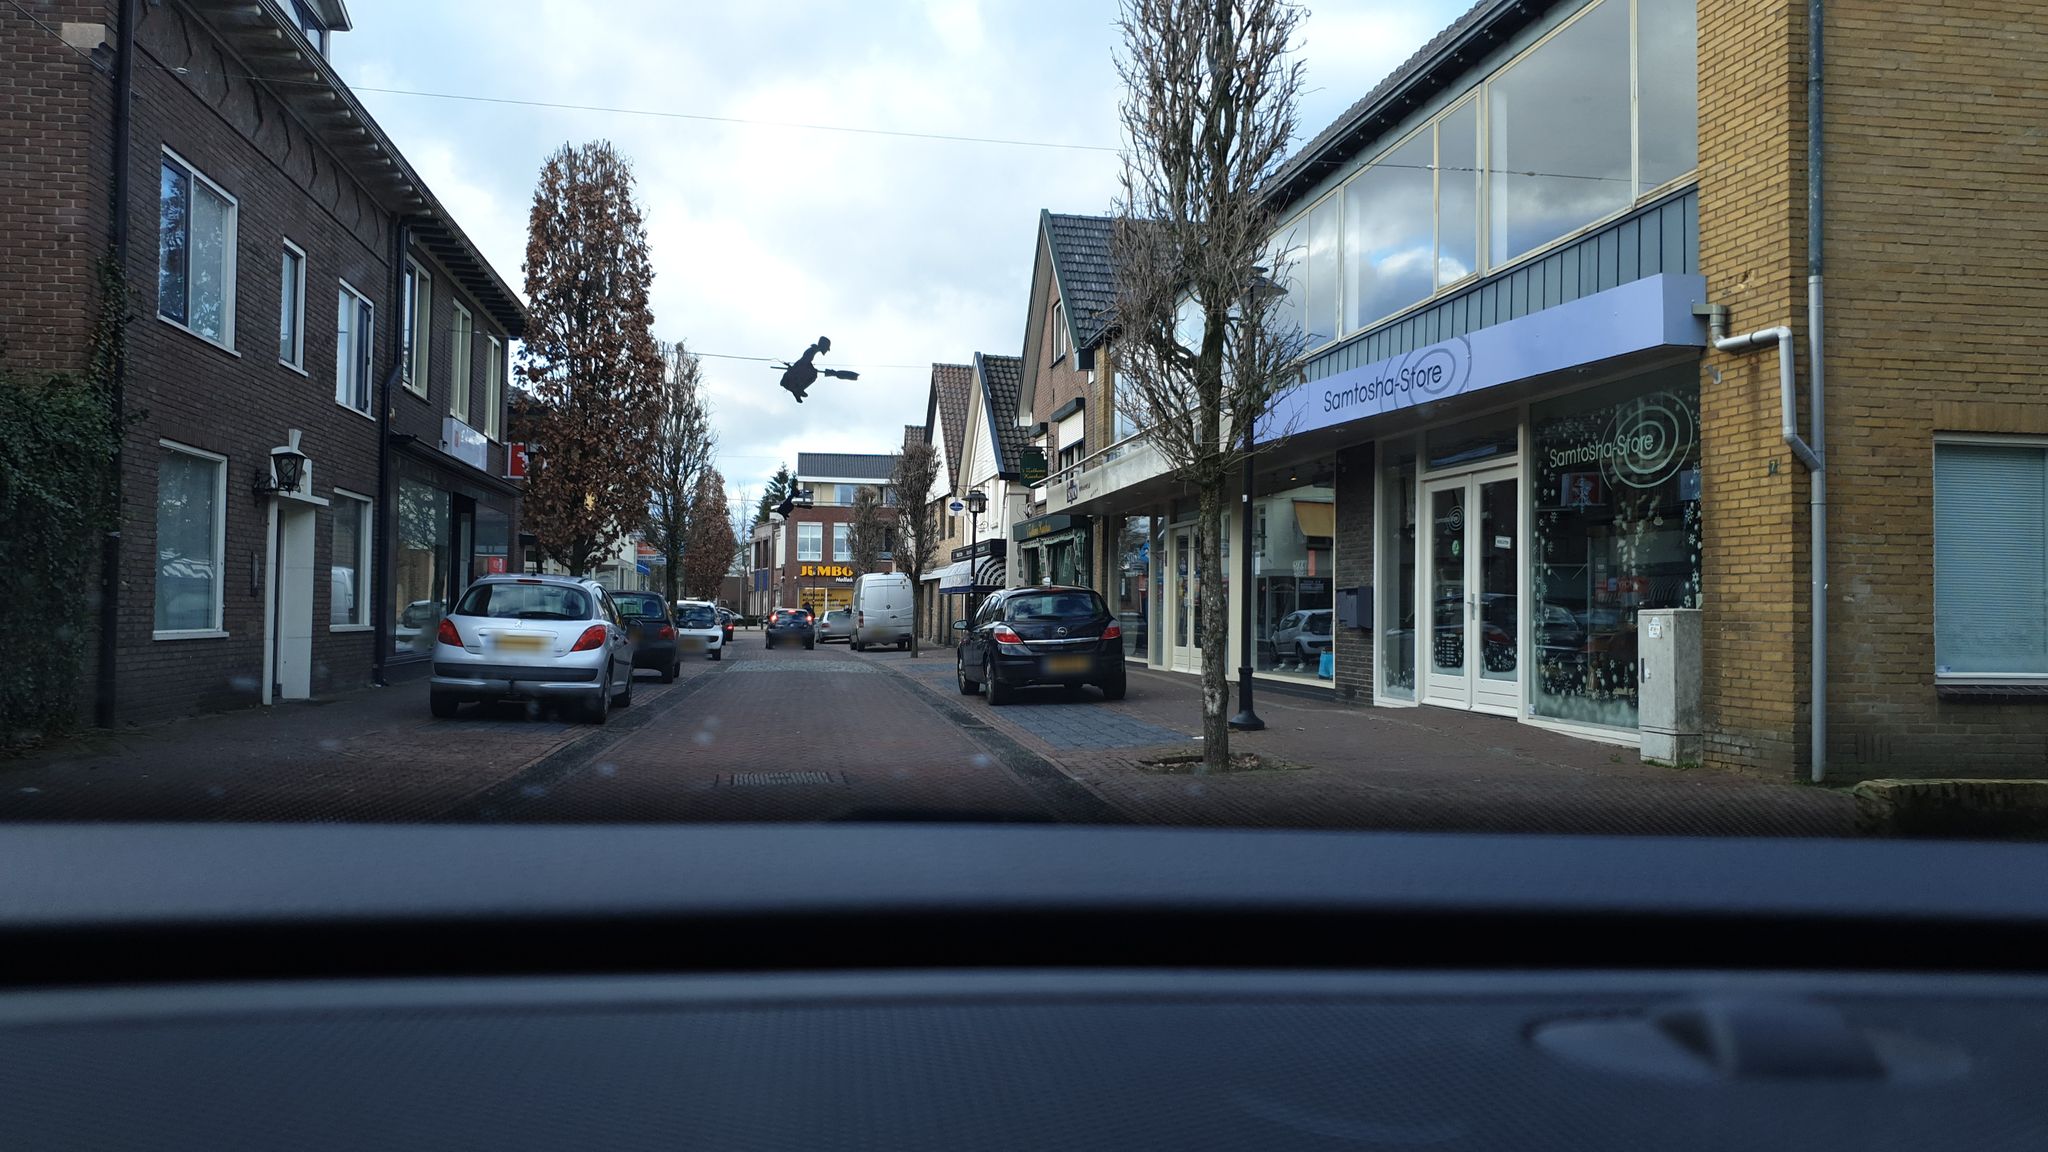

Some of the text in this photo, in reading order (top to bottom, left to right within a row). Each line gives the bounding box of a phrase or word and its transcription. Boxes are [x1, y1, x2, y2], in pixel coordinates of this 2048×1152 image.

[1323, 364, 1442, 412] Samtosha-Store
[1549, 433, 1654, 468] Samtosha-Store
[800, 565, 854, 577] JUMBO
